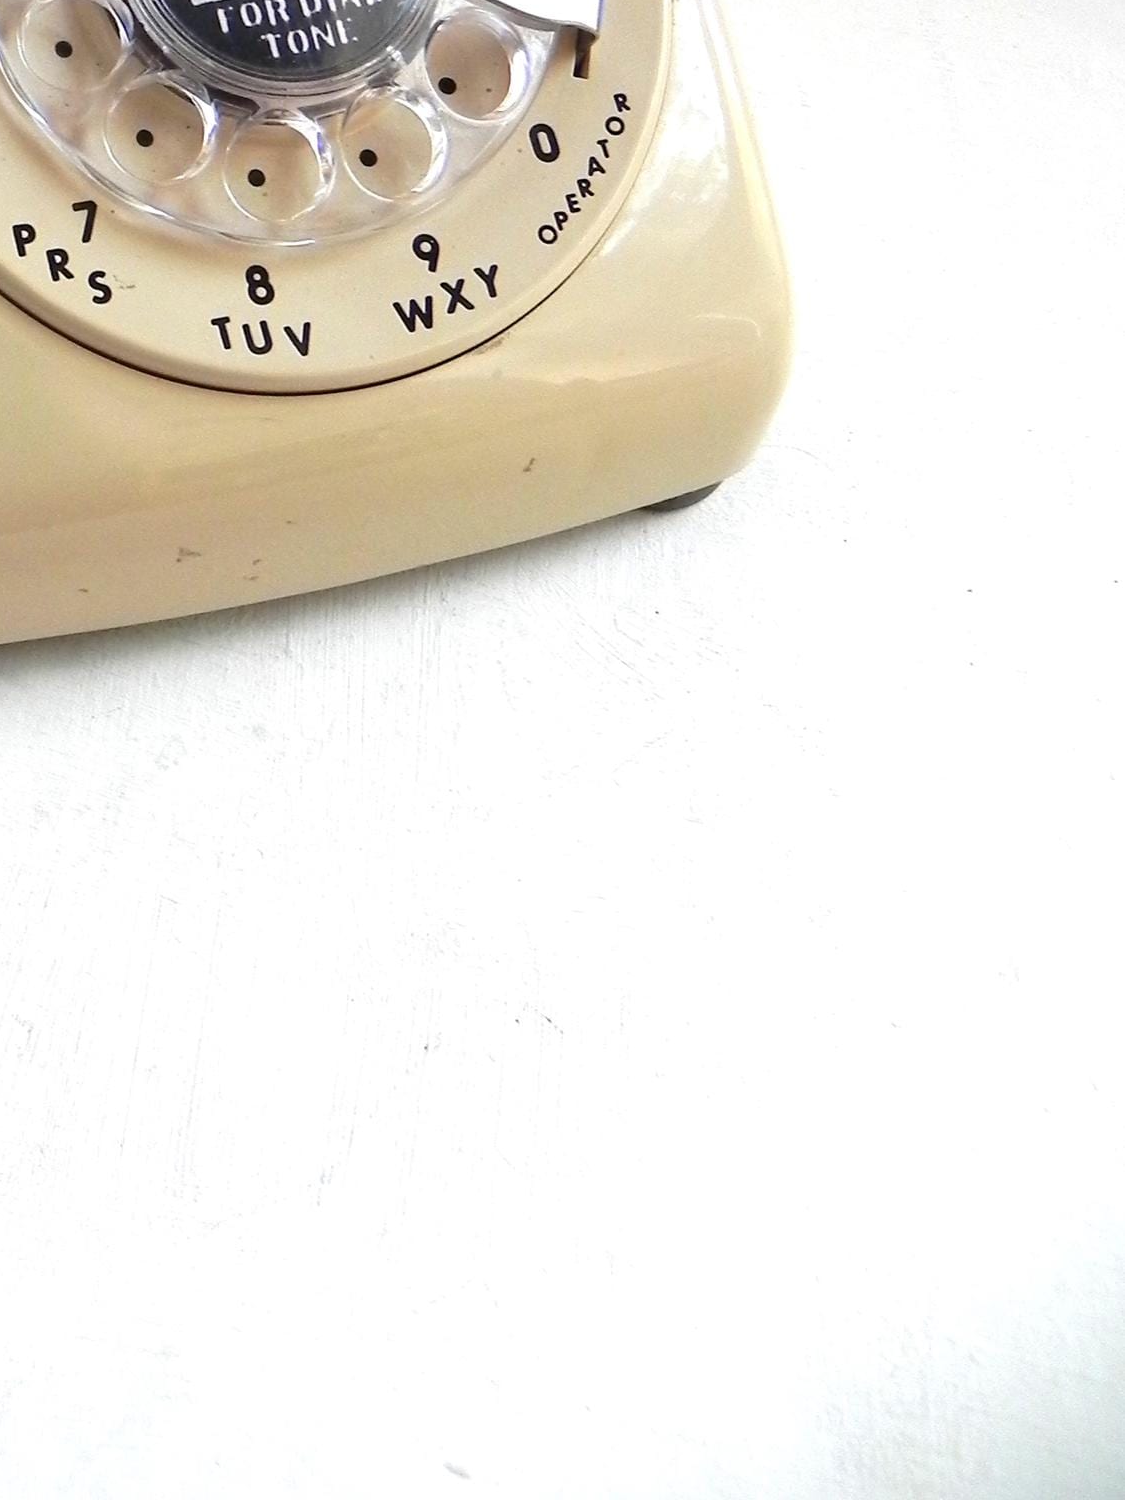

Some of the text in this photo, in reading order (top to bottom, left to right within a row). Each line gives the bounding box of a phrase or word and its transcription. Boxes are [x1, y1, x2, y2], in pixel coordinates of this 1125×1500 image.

[260, 17, 360, 60] TONE
[537, 92, 632, 245] OPERATOR
[71, 199, 98, 244] 7
[411, 233, 441, 273] 9
[244, 264, 276, 306] 8
[210, 315, 312, 357] TUV
